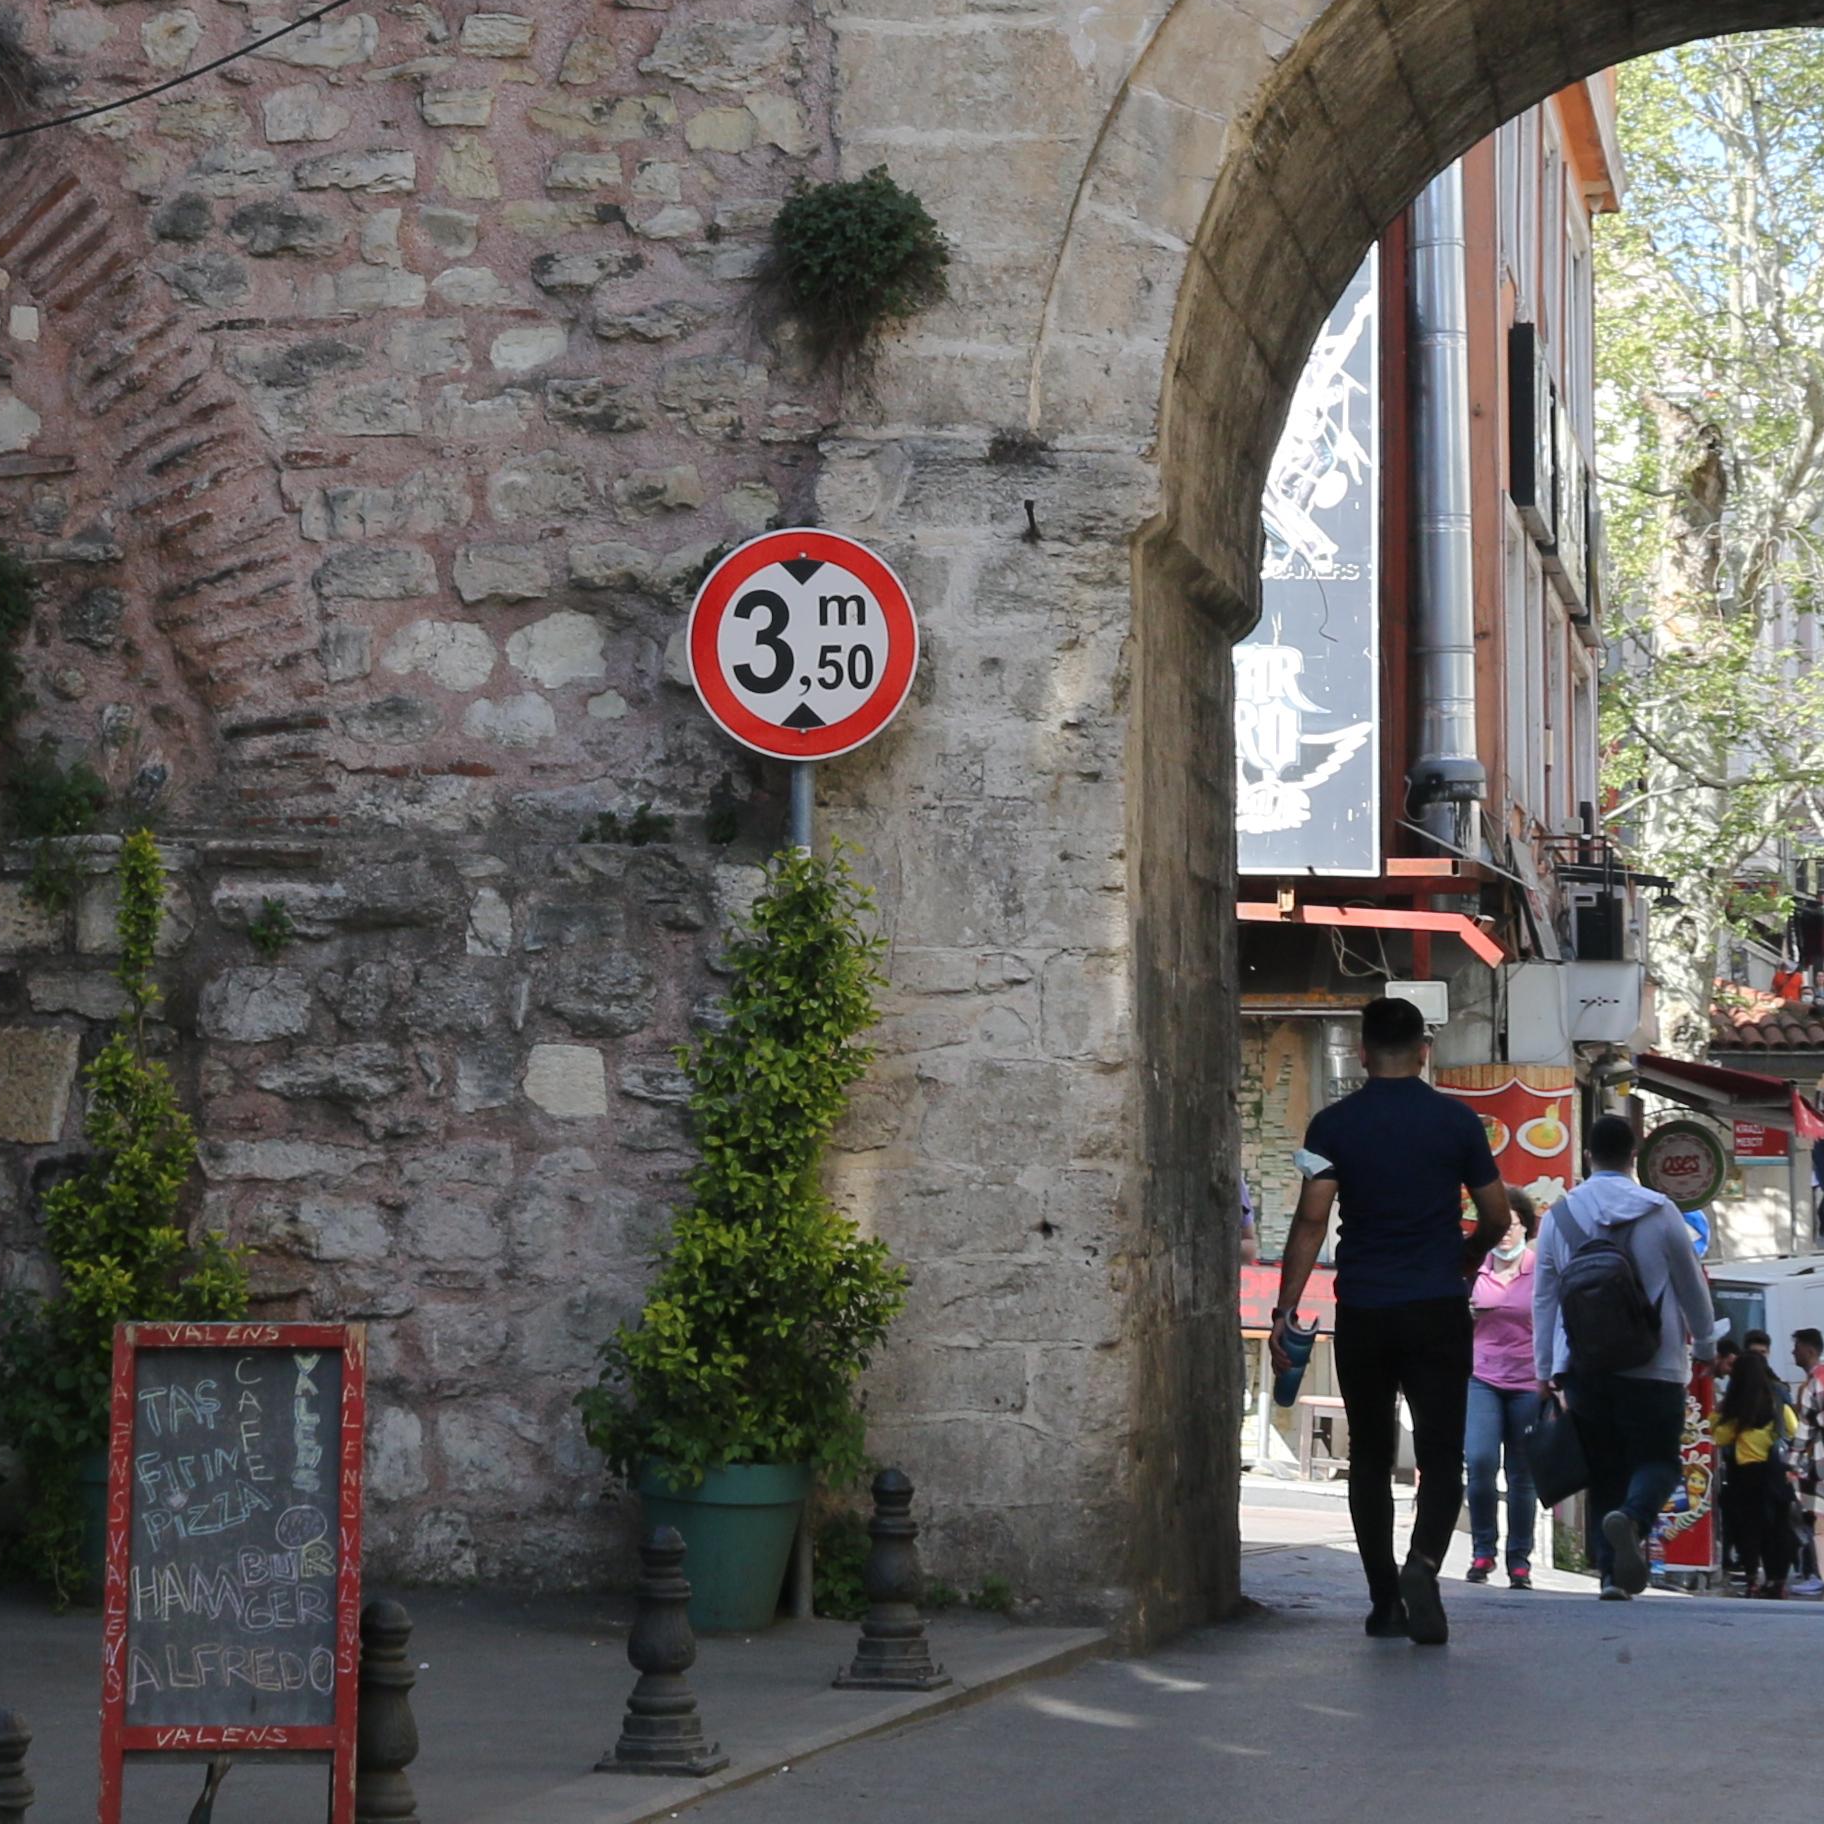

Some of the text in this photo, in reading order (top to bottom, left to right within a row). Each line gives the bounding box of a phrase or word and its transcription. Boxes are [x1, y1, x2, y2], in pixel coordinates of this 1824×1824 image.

[818, 594, 867, 627] m
[166, 1326, 279, 1343] VALENS
[235, 1356, 274, 1482] CAFE
[128, 1643, 335, 1705] ALFREDO
[156, 1726, 288, 1746] VALENS
